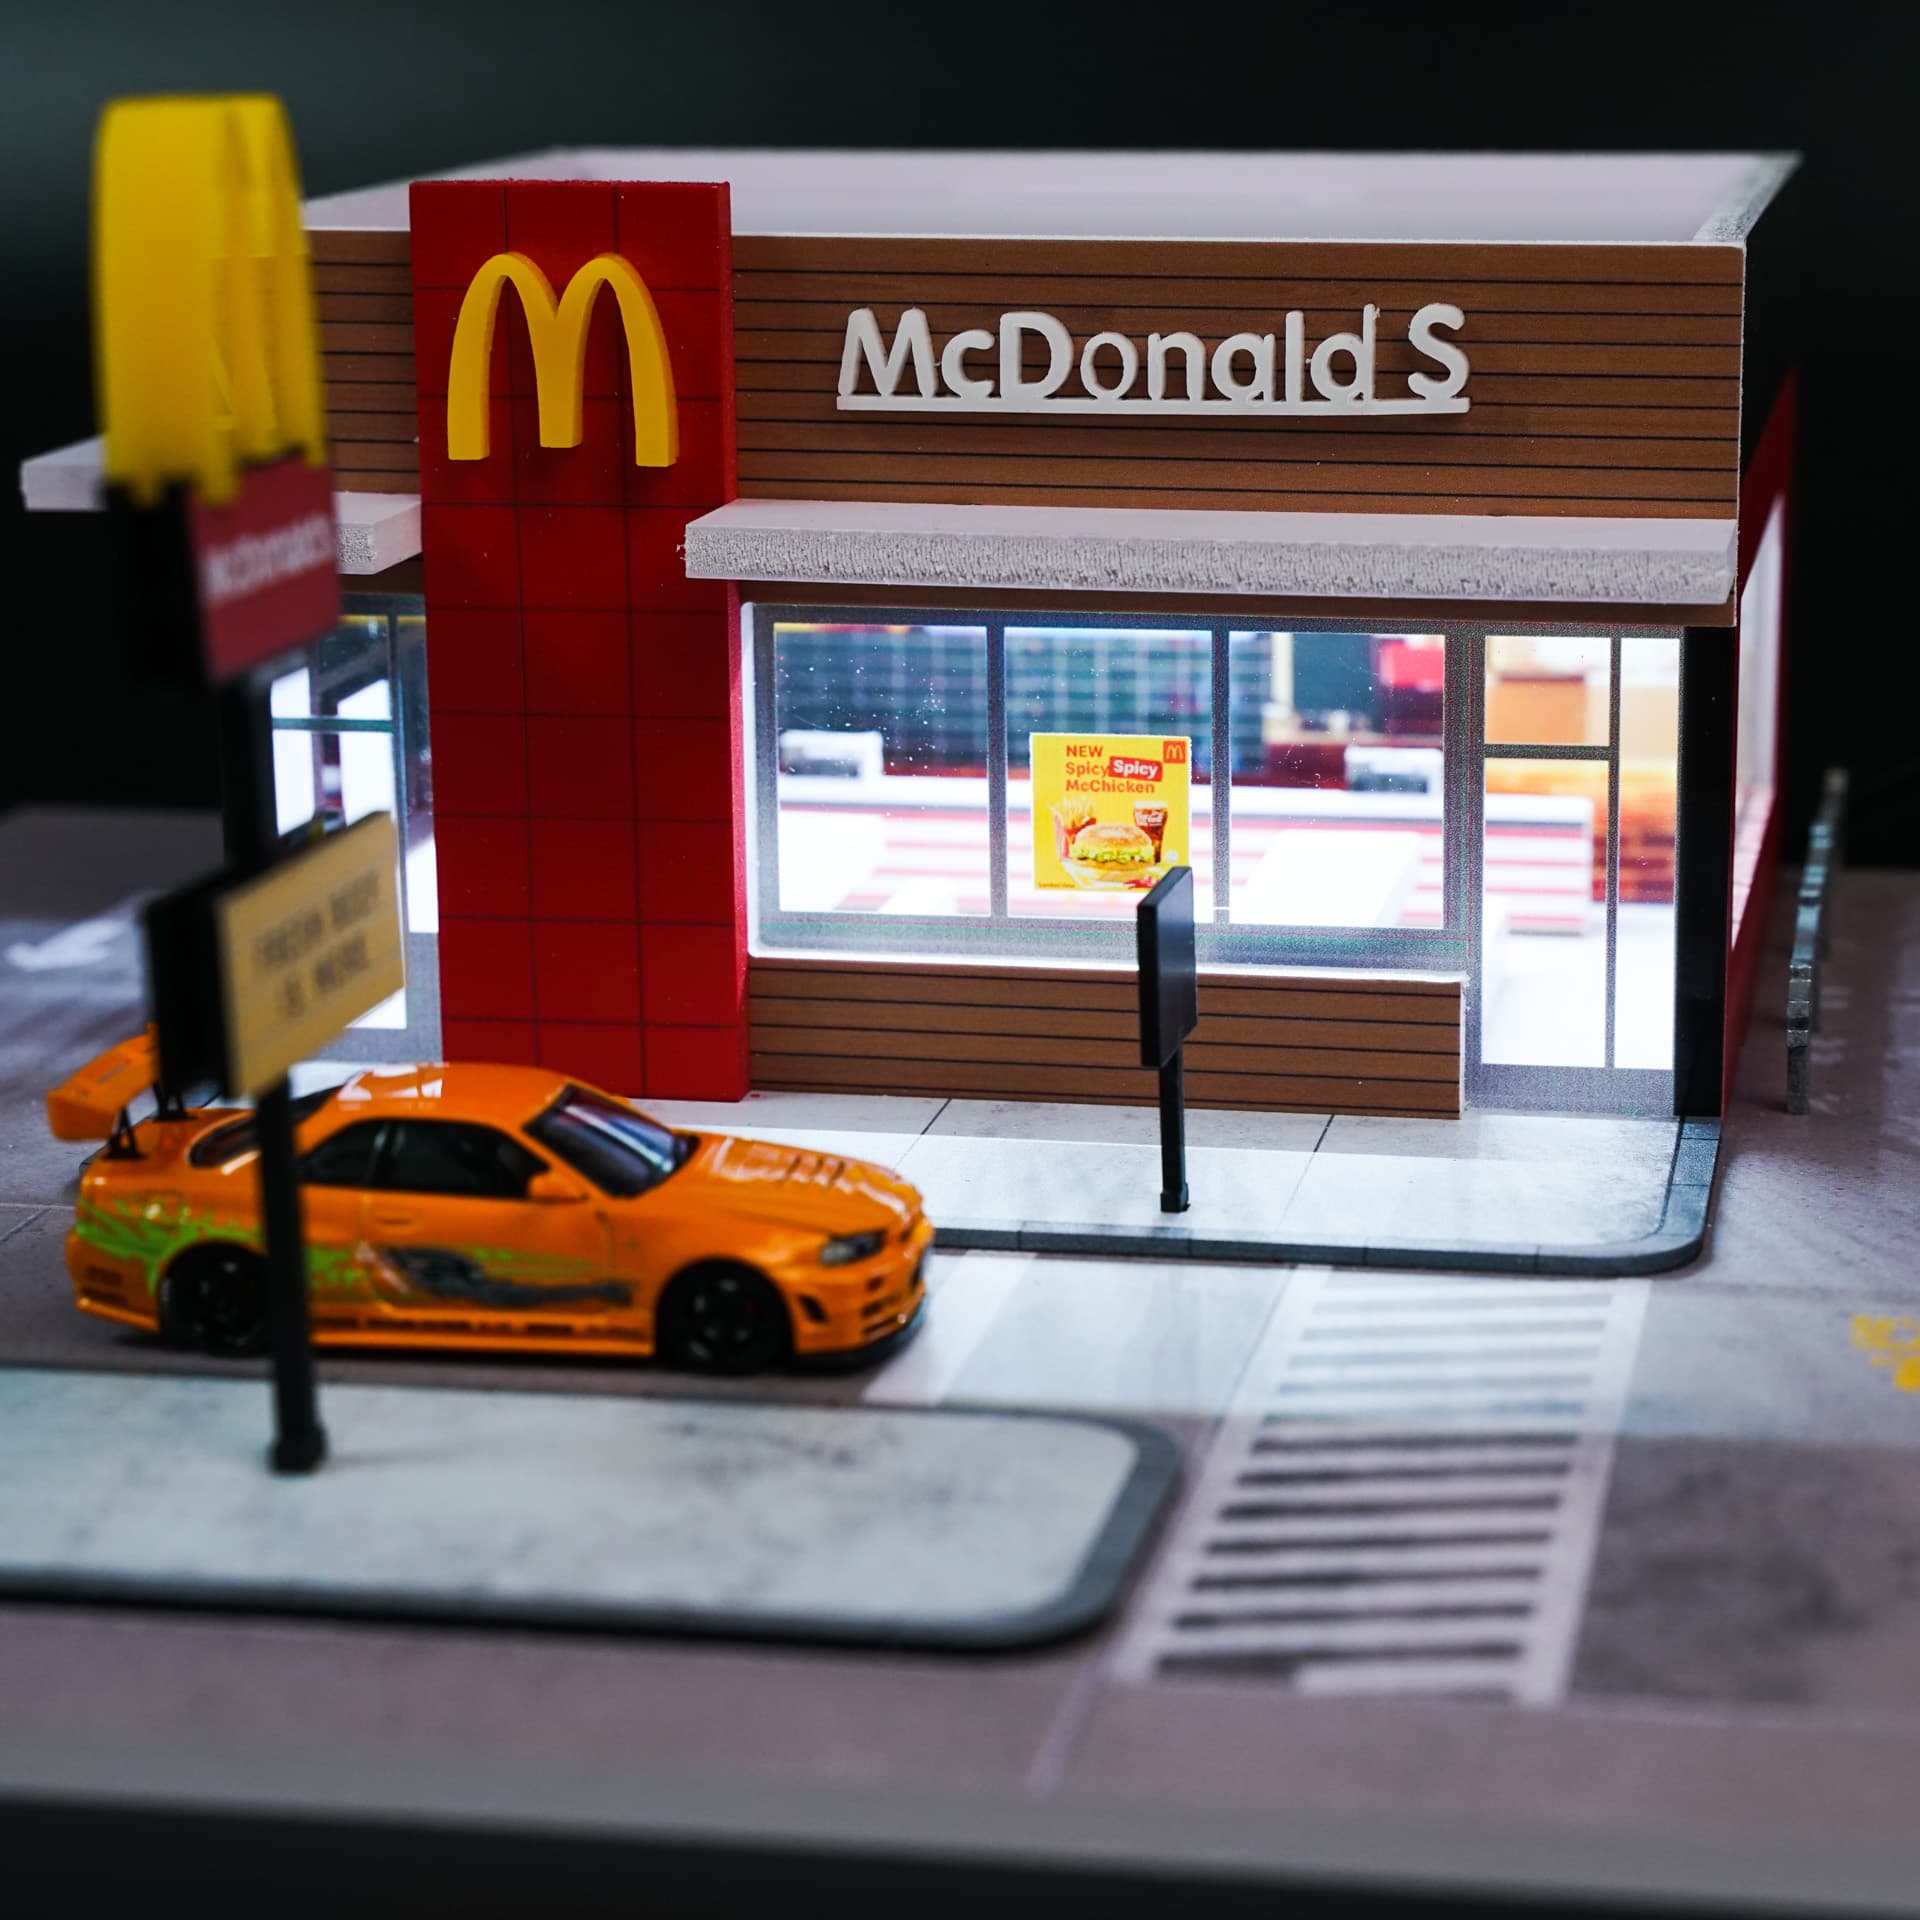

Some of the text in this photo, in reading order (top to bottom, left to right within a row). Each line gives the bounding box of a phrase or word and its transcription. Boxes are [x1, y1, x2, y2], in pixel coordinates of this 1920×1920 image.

[448, 252, 679, 467] M
[838, 303, 1377, 403] McDonald
[1066, 744, 1103, 757] NEW
[1066, 759, 1158, 779] Spicy Spicy
[1066, 780, 1155, 793] McChicken
